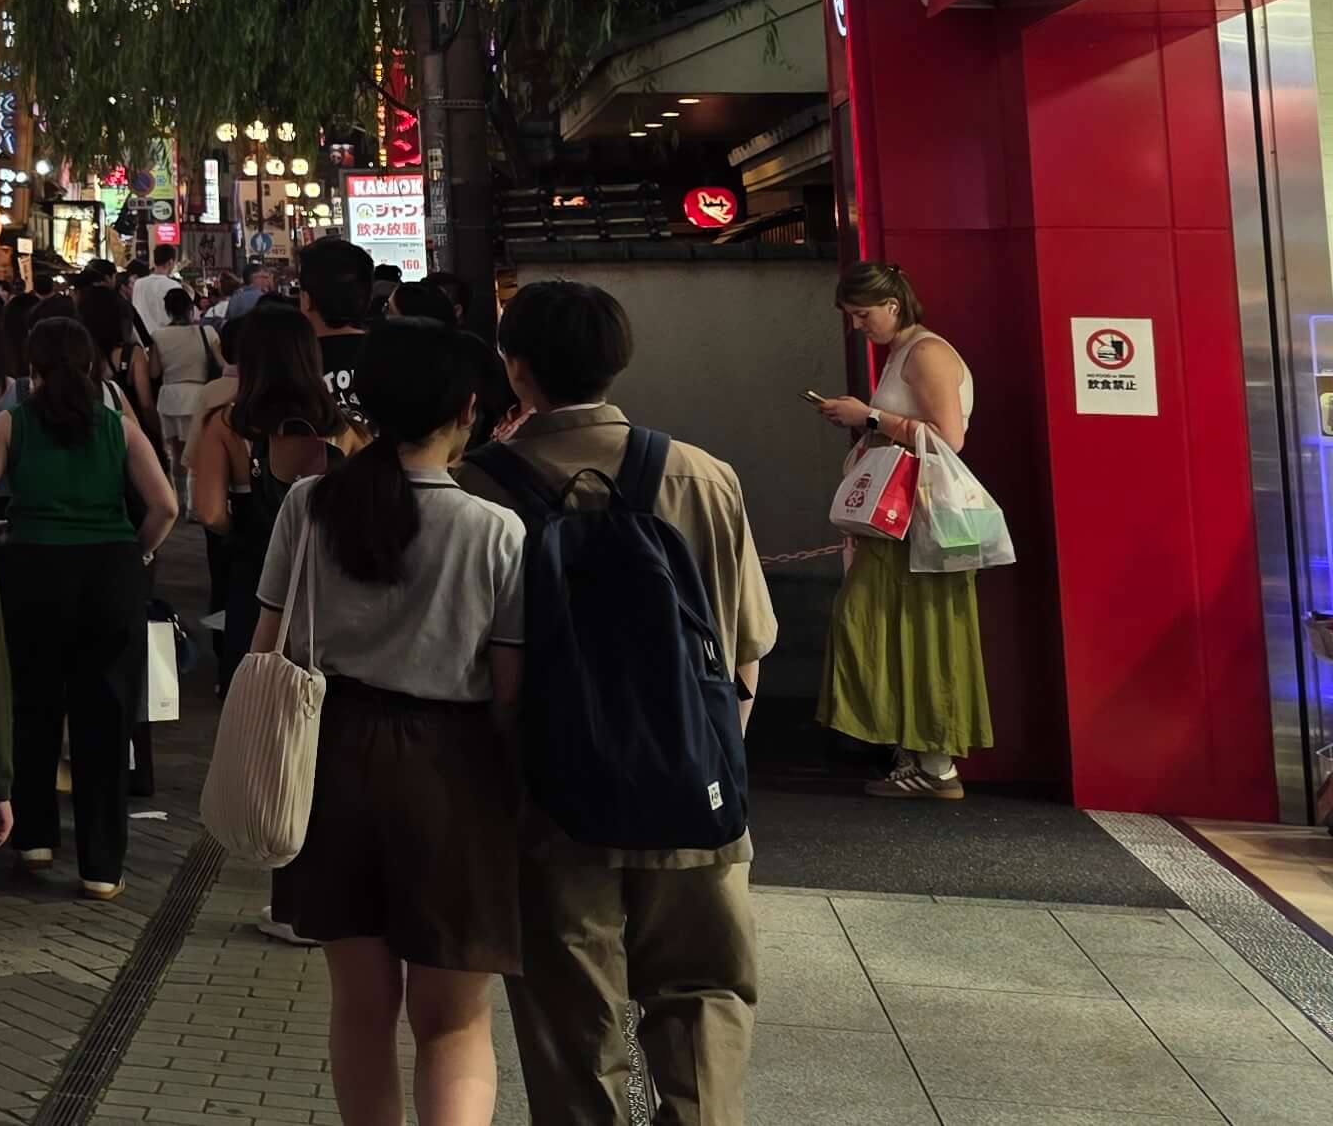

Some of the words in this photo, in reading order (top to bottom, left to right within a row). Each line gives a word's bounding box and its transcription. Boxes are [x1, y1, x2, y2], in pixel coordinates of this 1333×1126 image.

[375, 203, 425, 219] ジャン
[356, 222, 418, 237] 飲み放題
[1087, 379, 1138, 391] 飲食禁止
